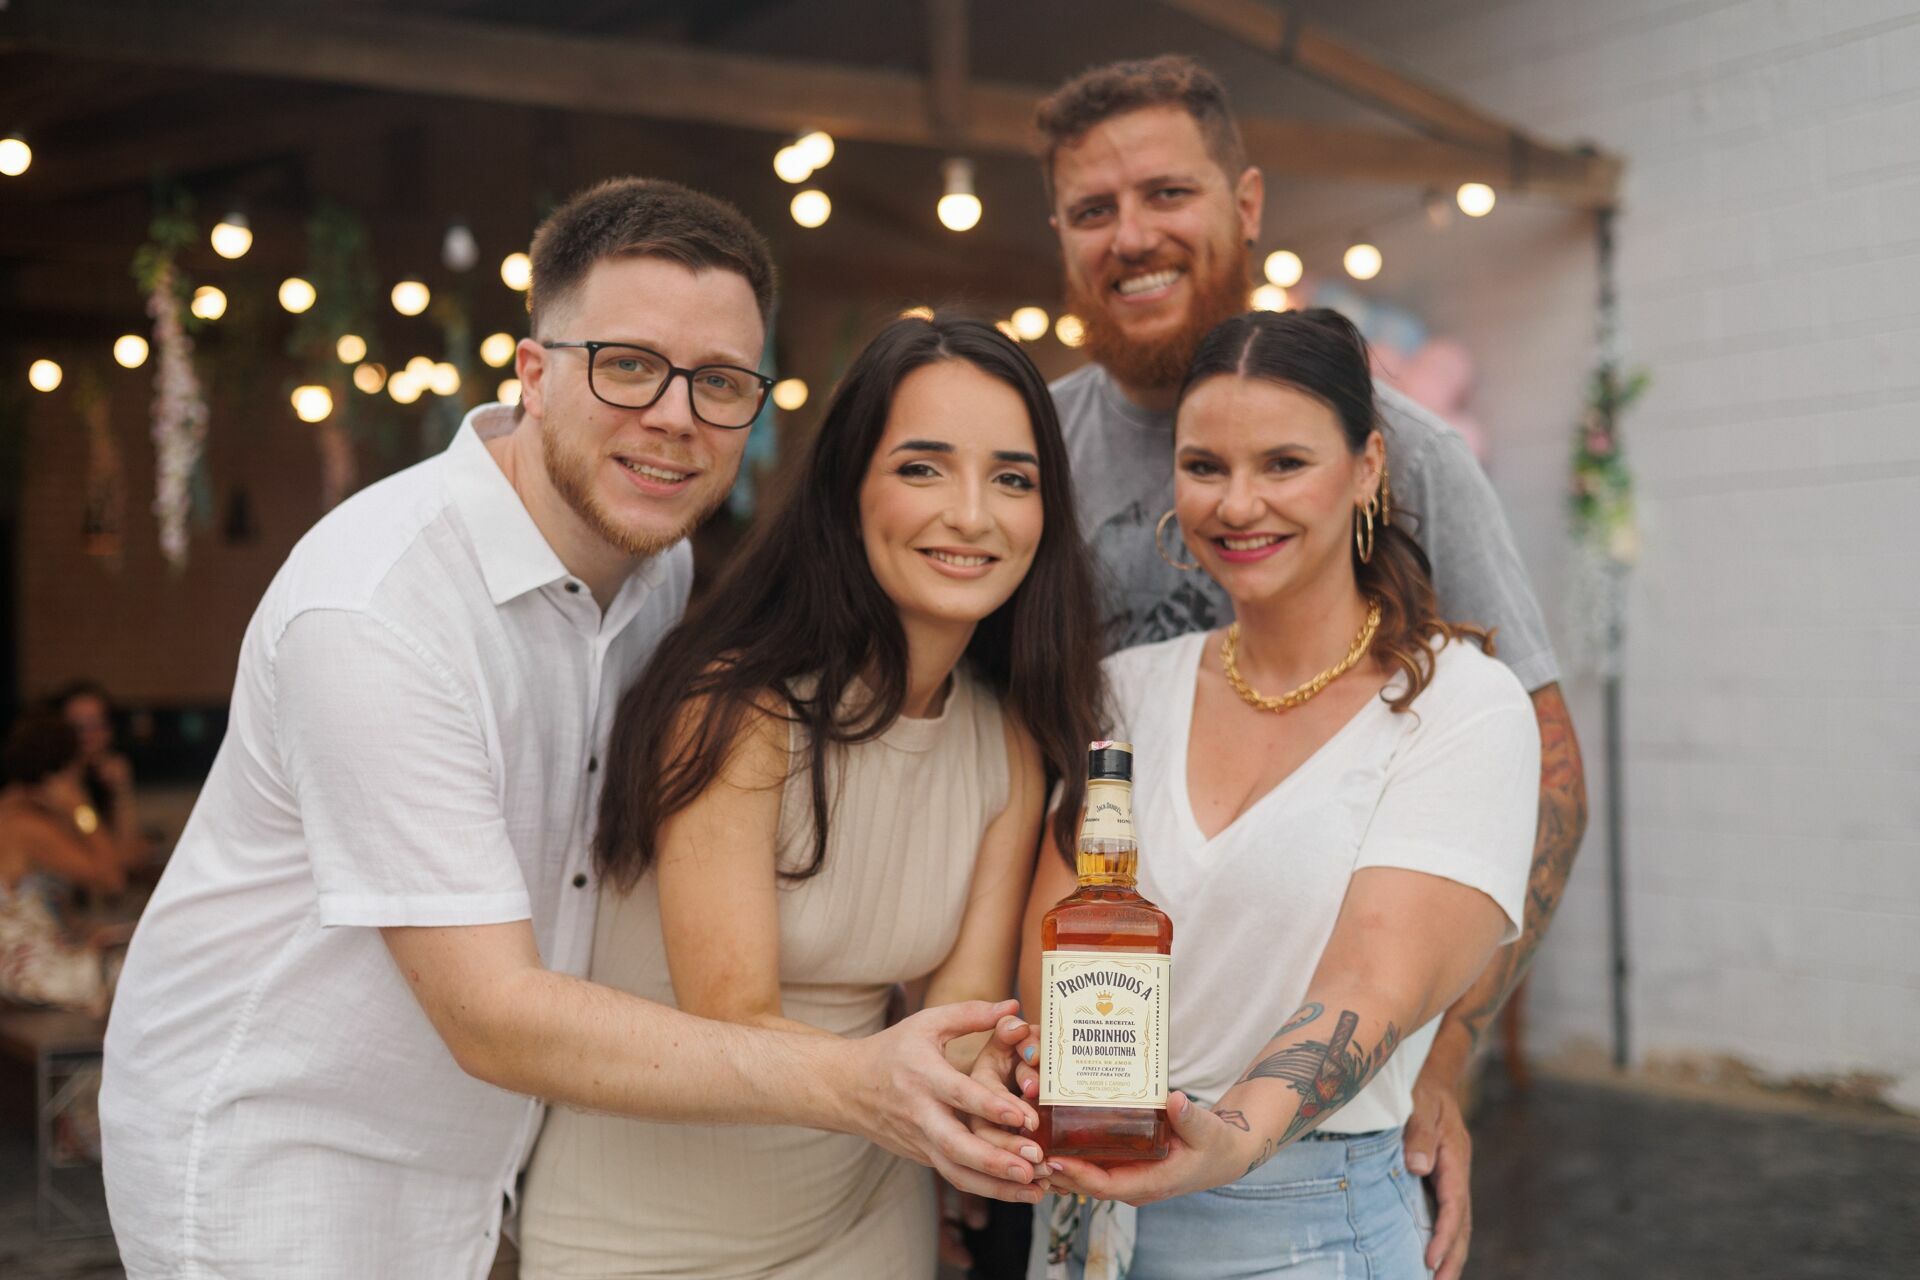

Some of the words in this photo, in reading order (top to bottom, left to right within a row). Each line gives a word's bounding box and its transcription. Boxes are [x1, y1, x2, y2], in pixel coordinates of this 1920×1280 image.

[1056, 971, 1144, 998] PROMOVIDOS
[1140, 987, 1153, 1001] A
[1072, 1028, 1136, 1043] PADRINHOS
[1072, 1045, 1093, 1057] DO(A)
[1094, 1046, 1136, 1057] BOLOTINHA
